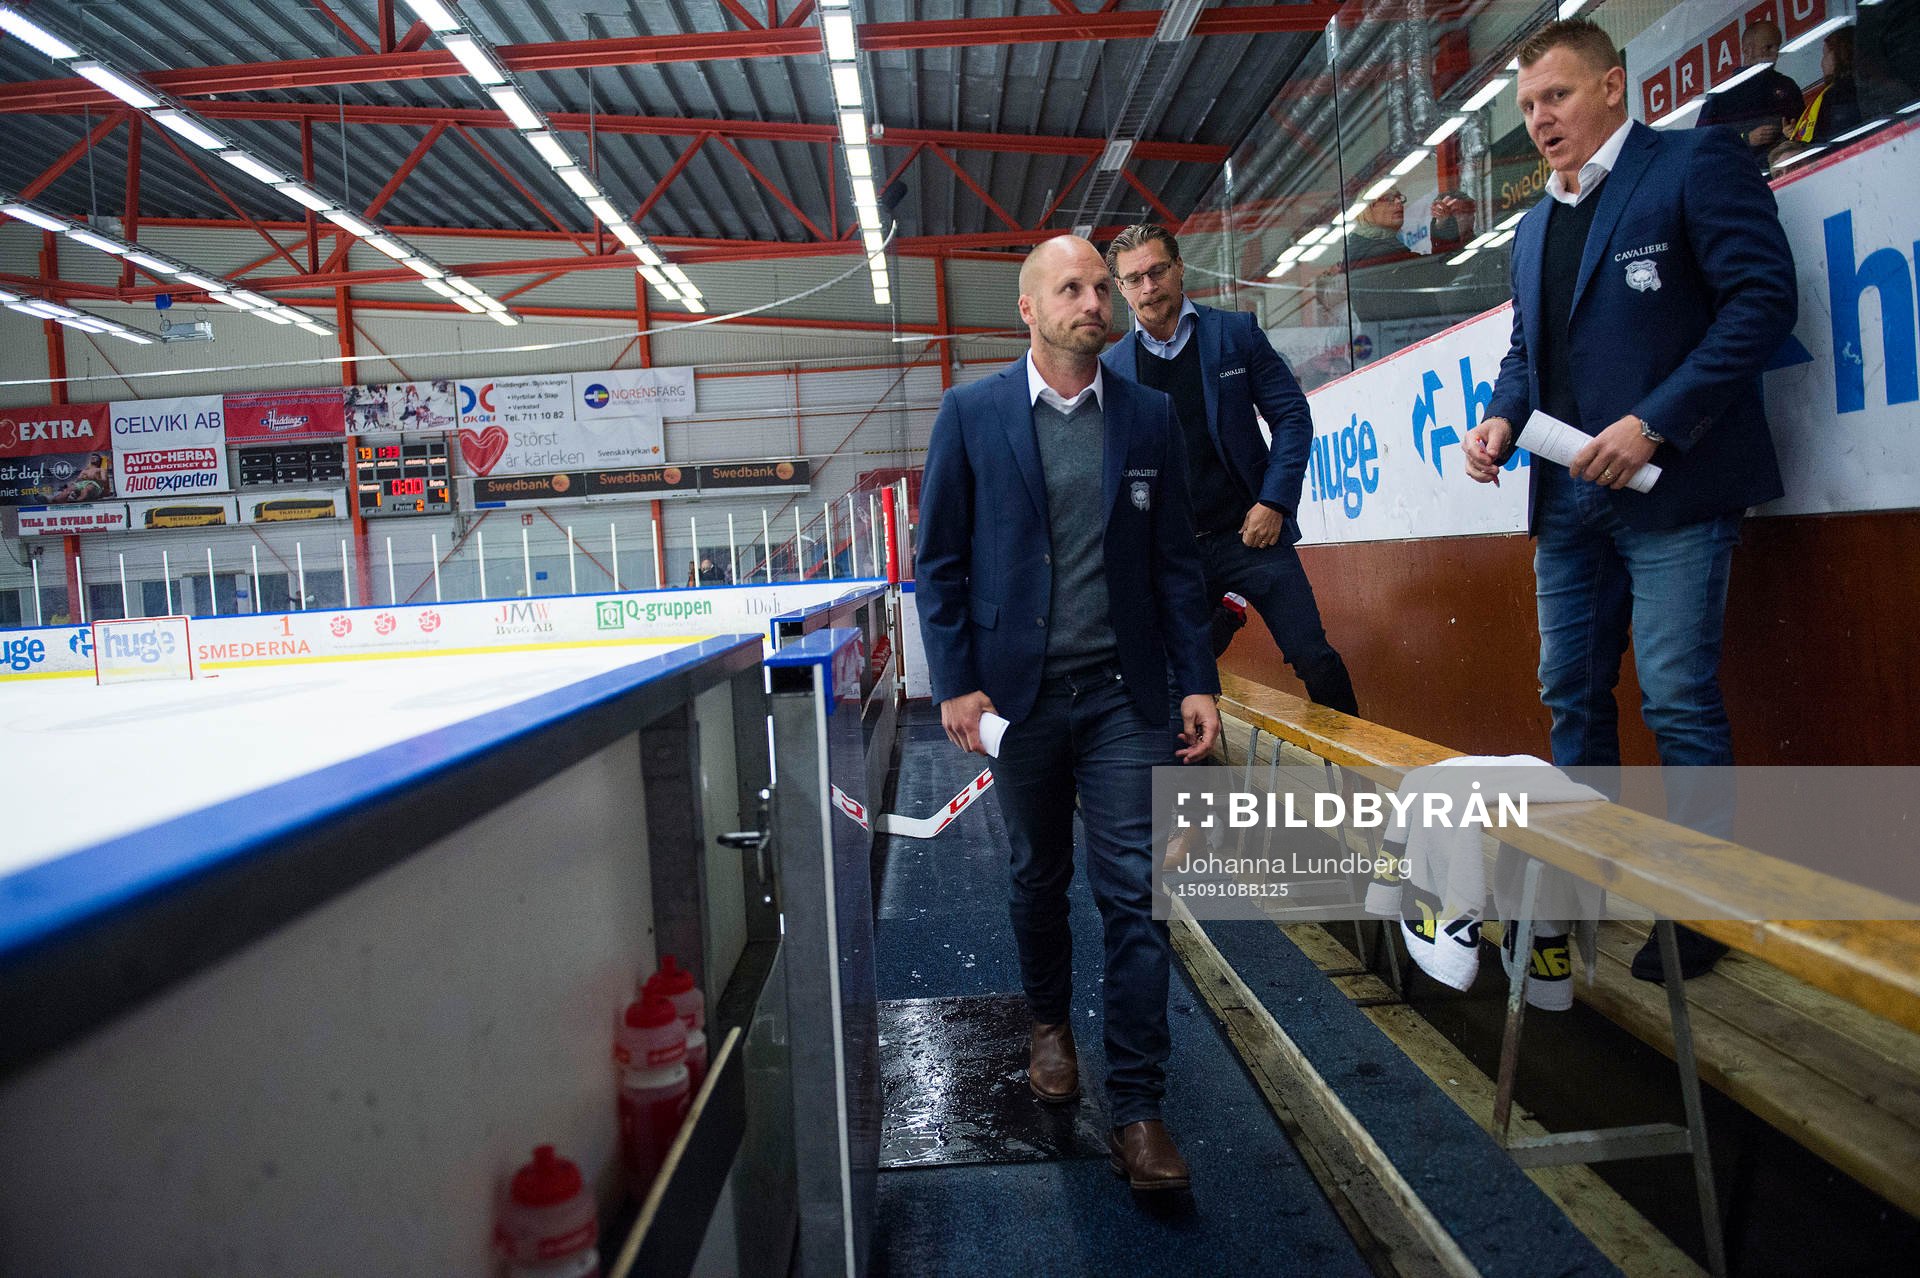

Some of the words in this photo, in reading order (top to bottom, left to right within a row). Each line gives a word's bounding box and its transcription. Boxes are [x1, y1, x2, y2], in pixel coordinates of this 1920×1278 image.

[1614, 242, 1669, 262] CAVALIERE
[114, 413, 188, 435] CELVIKI
[194, 411, 221, 430] AB
[504, 414, 520, 422] Tel.
[522, 413, 537, 421] 711
[541, 412, 551, 420] 10
[553, 411, 565, 419] 82
[19, 418, 94, 441] EXTRA
[514, 431, 560, 447] Störst
[127, 450, 214, 465] AUTO-HERBA
[505, 453, 518, 468] är
[525, 448, 585, 466] kärleken
[597, 448, 625, 457] Svenska
[626, 447, 651, 457] kyrkan
[1, 465, 18, 481] åt
[18, 462, 45, 486] dig!
[599, 471, 662, 485] Swedbank
[712, 465, 775, 479] Swedbank
[125, 472, 218, 493] Autoexperten
[391, 478, 424, 496] 0:00
[487, 479, 550, 493] Swedbank
[438, 487, 449, 503] 4
[416, 498, 425, 512] 2
[494, 602, 549, 624] JMW
[625, 599, 712, 622] Q-gruppen
[103, 627, 175, 663] huge
[199, 639, 312, 660] SMEDERNA
